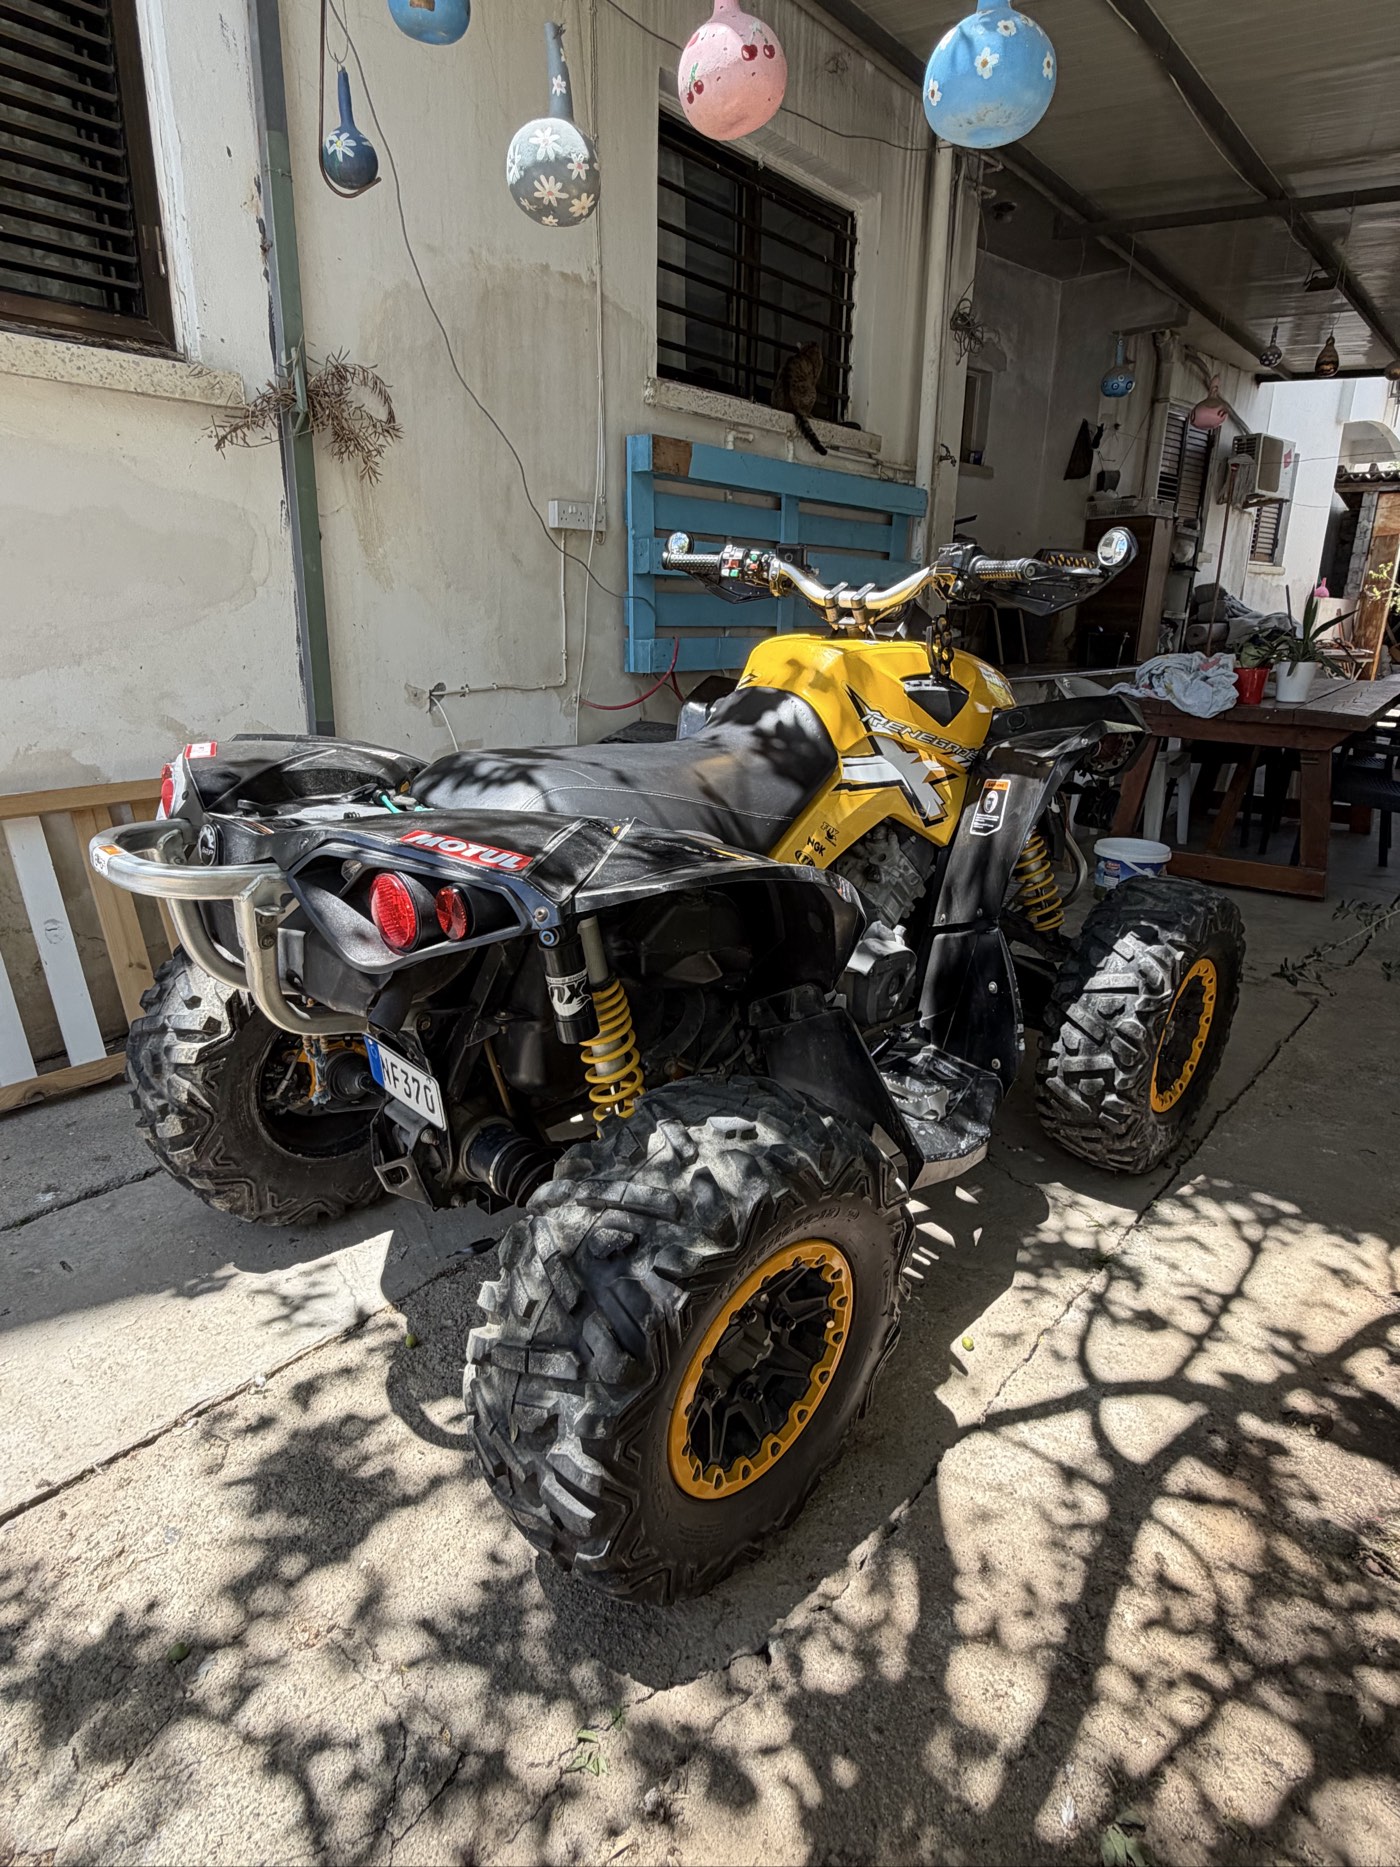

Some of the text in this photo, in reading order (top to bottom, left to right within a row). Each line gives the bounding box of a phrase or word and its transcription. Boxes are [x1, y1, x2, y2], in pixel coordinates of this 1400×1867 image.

[861, 713, 978, 762] RENEGADE
[405, 833, 523, 869] MOTUL
[806, 836, 826, 857] NGK
[380, 1054, 435, 1114] NF370
